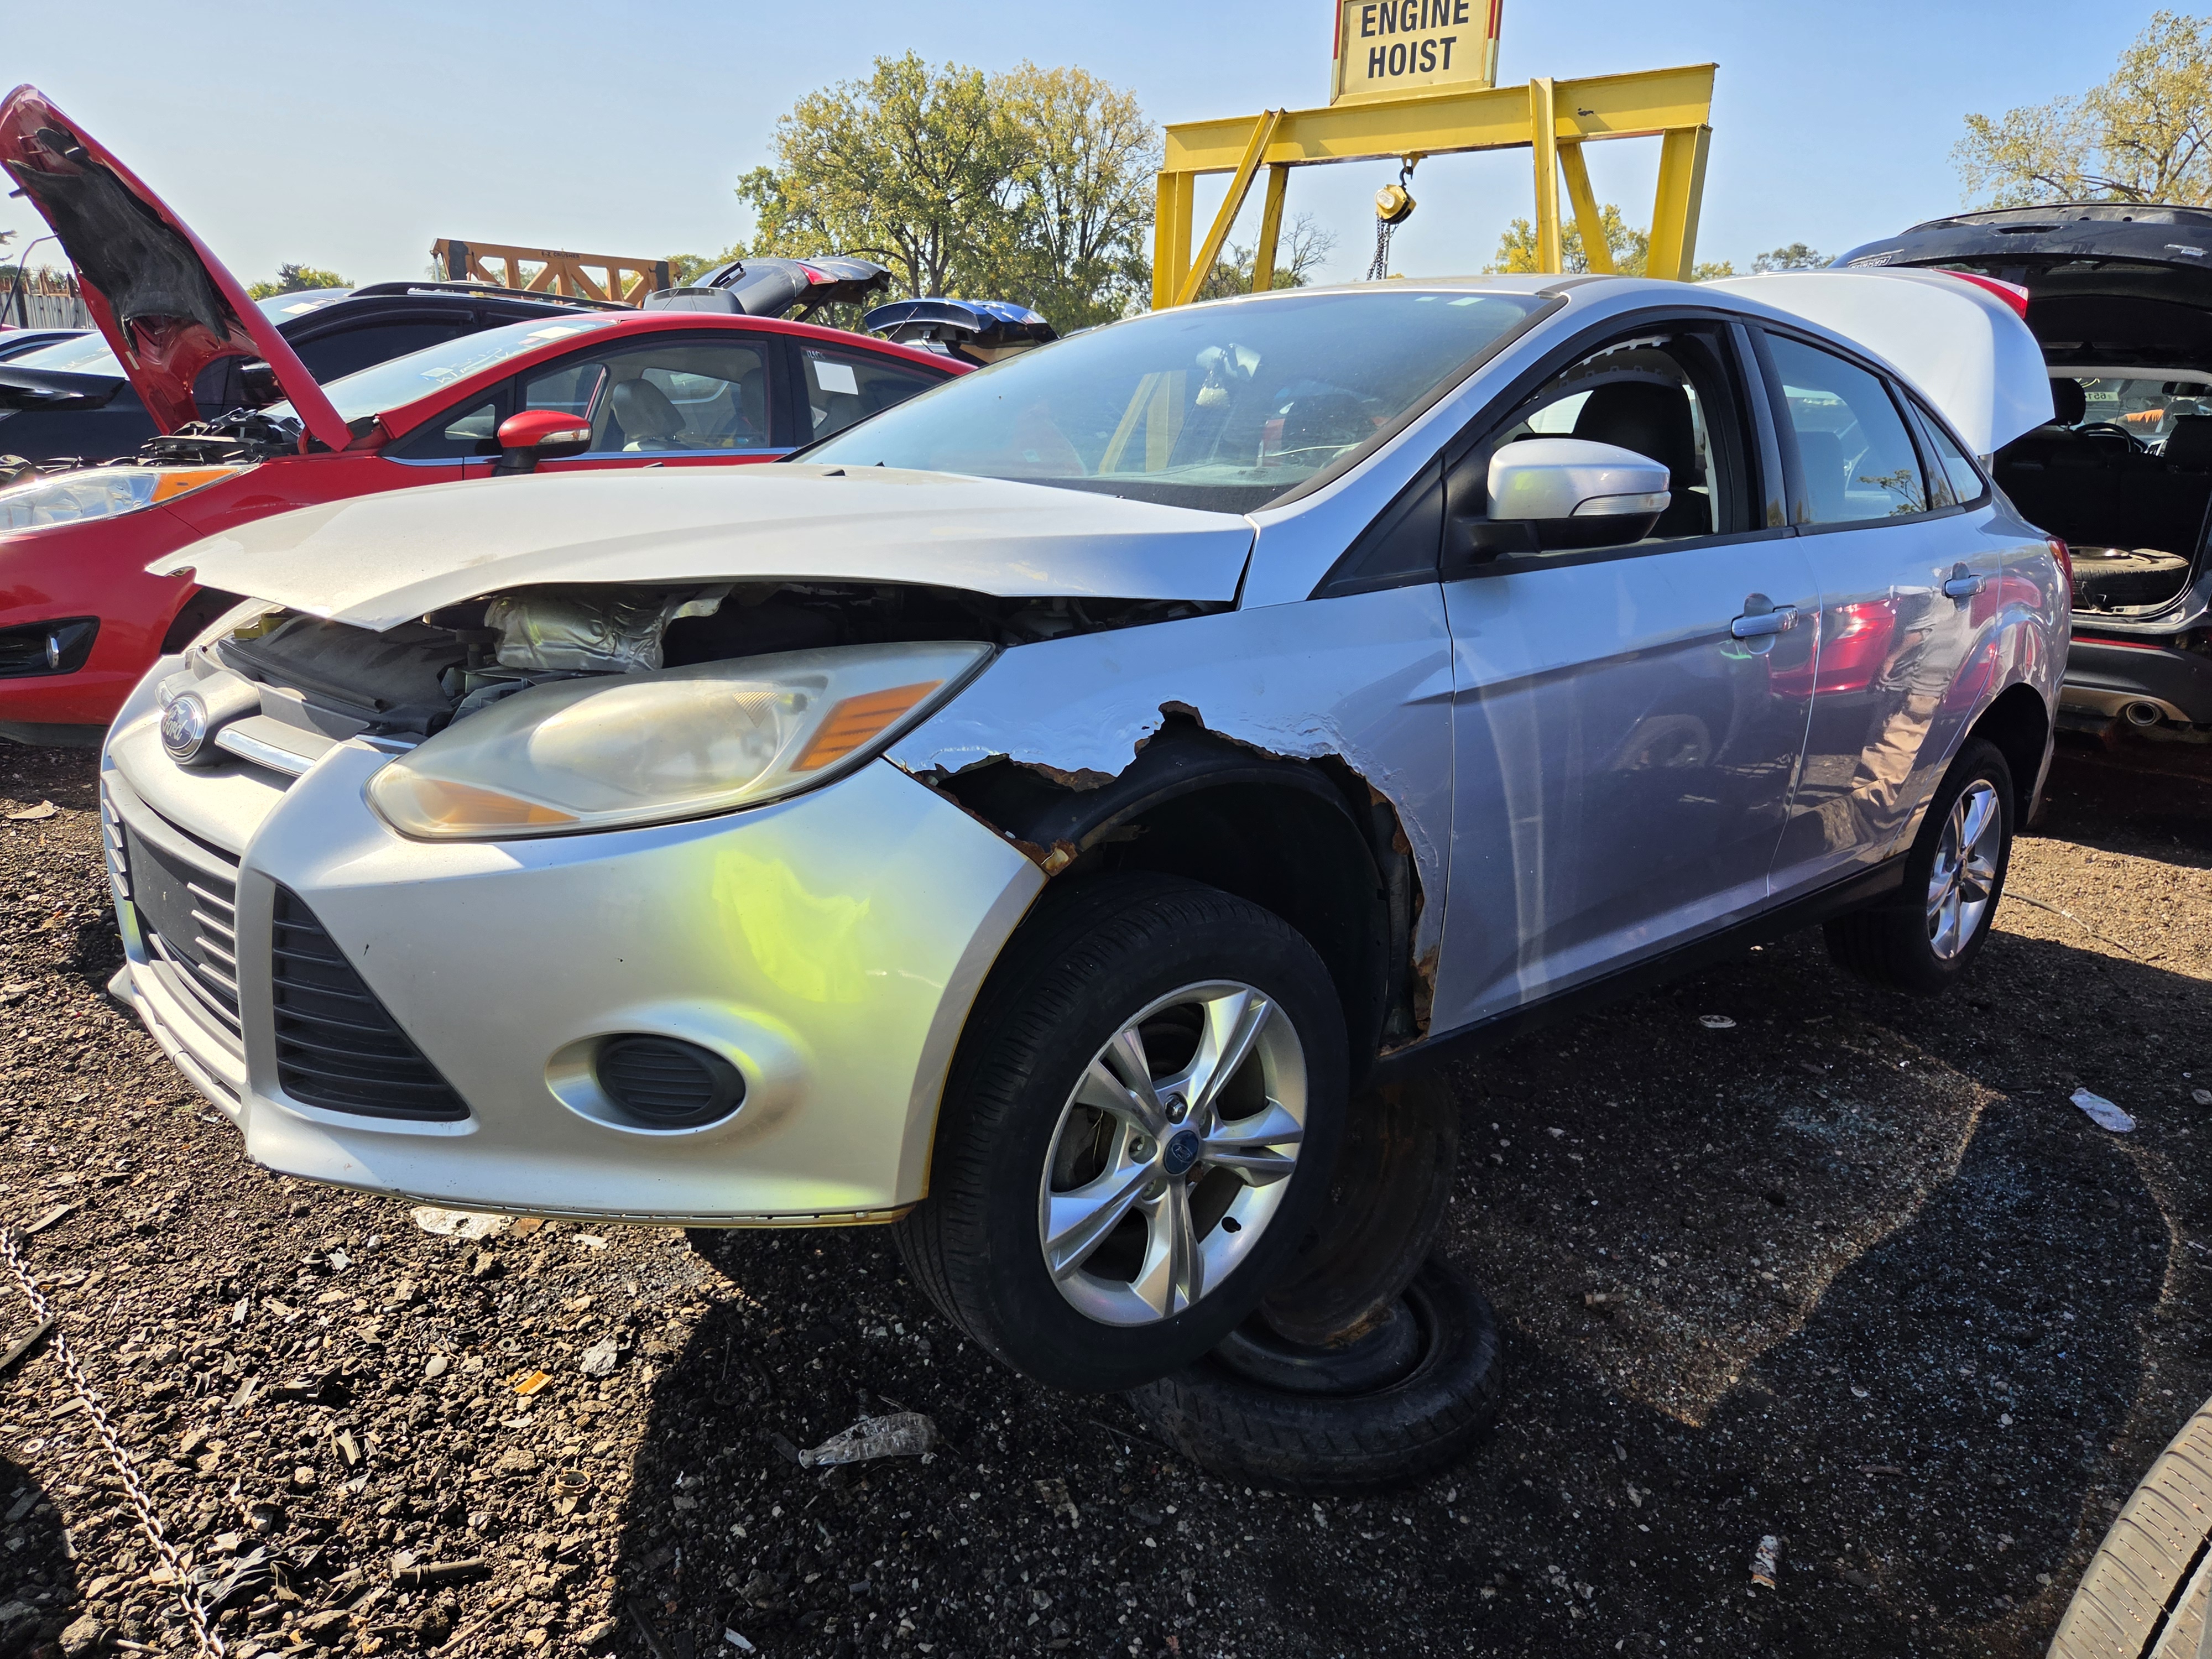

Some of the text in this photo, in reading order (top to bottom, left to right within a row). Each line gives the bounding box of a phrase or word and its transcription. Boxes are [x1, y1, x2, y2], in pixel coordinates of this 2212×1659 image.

[1361, 0, 1469, 38] ENGINE
[1368, 36, 1457, 79] HOIST
[163, 704, 189, 741] Ford
